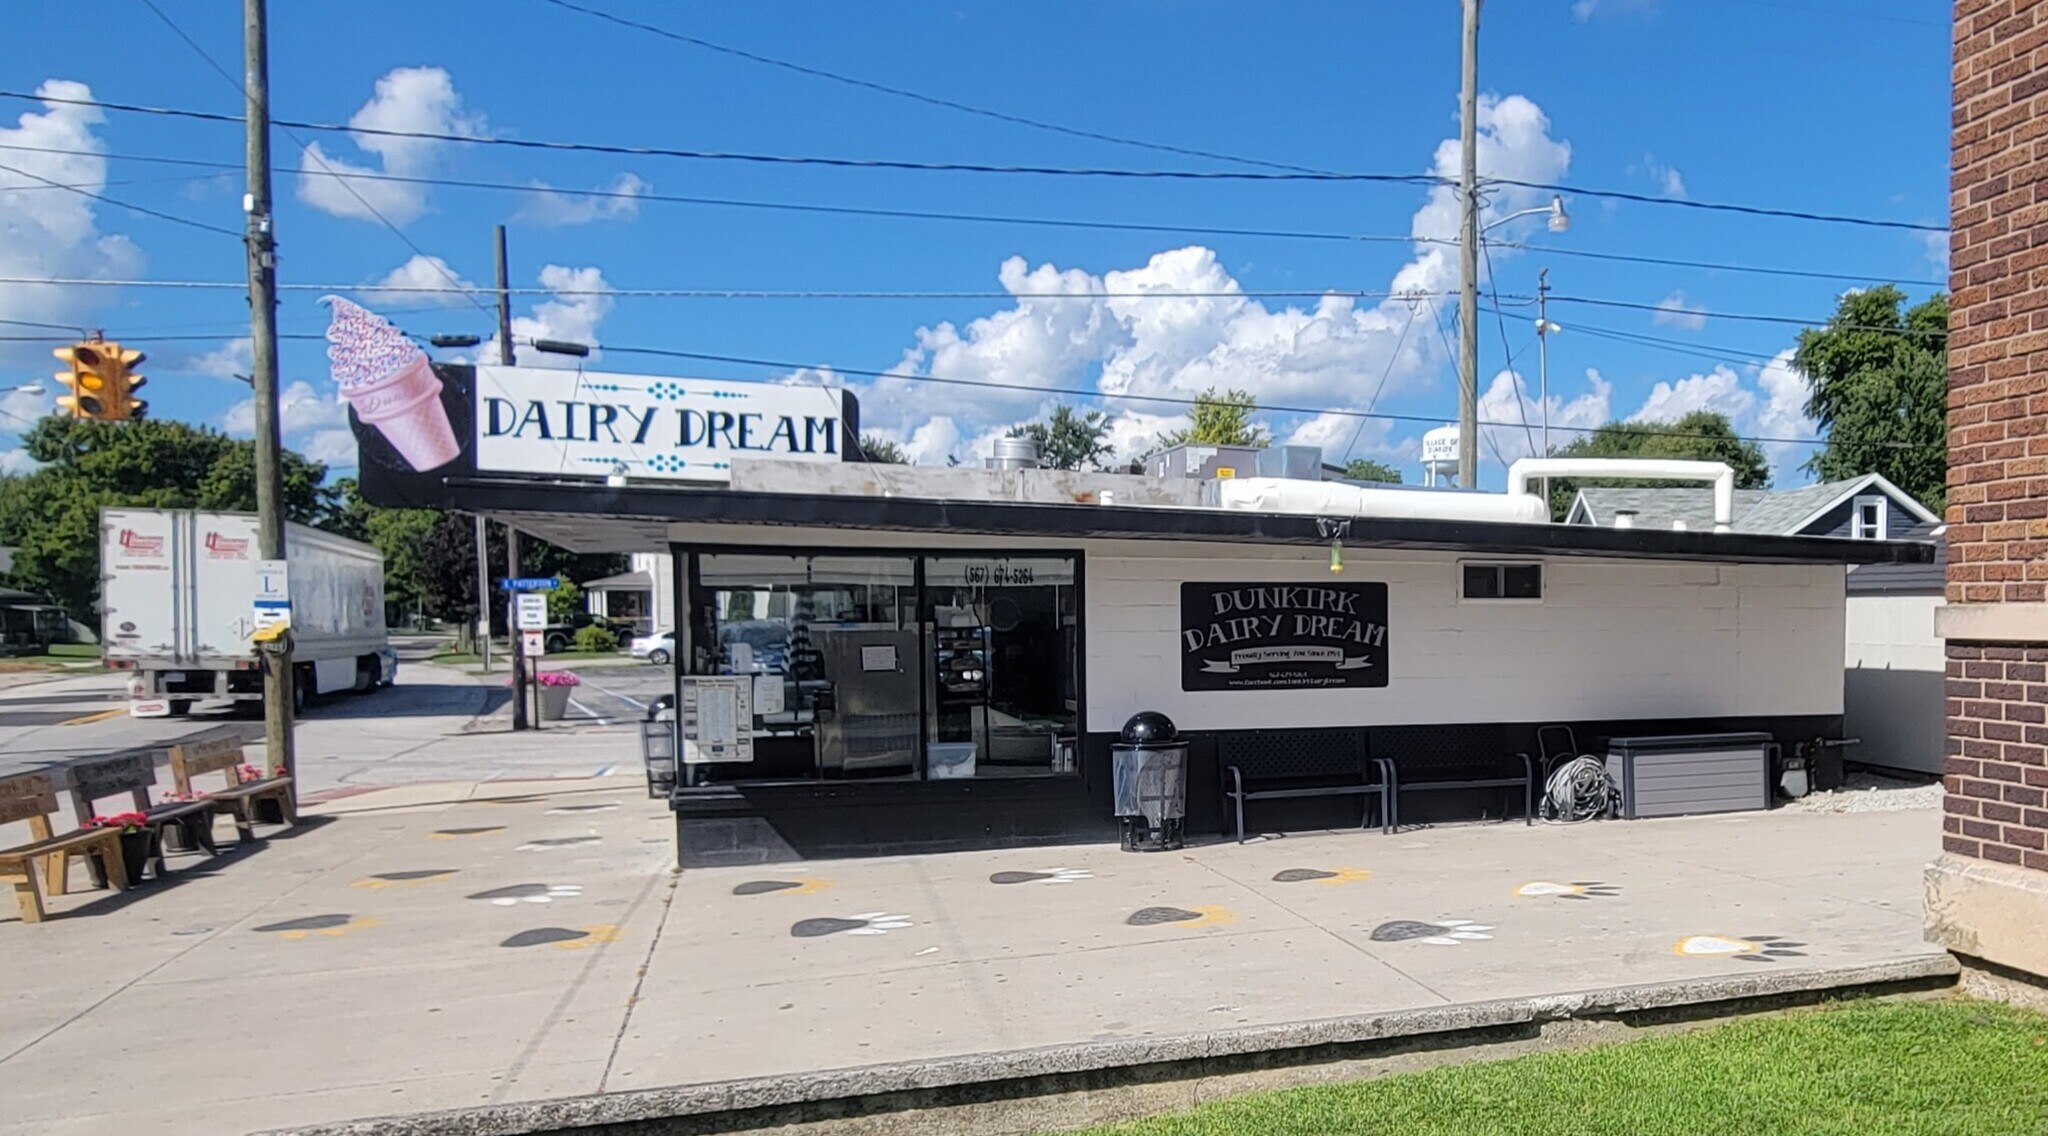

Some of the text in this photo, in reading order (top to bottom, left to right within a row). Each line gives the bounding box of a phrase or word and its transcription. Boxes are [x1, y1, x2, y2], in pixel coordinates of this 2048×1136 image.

[483, 396, 838, 454] DAIRY DREAM
[264, 576, 278, 593] L
[964, 564, 1034, 585] (567) 674-5264
[1211, 586, 1360, 616] DUNKIRK
[1182, 614, 1388, 653] DAIRY DREAM
[1263, 650, 1290, 659] Serving
